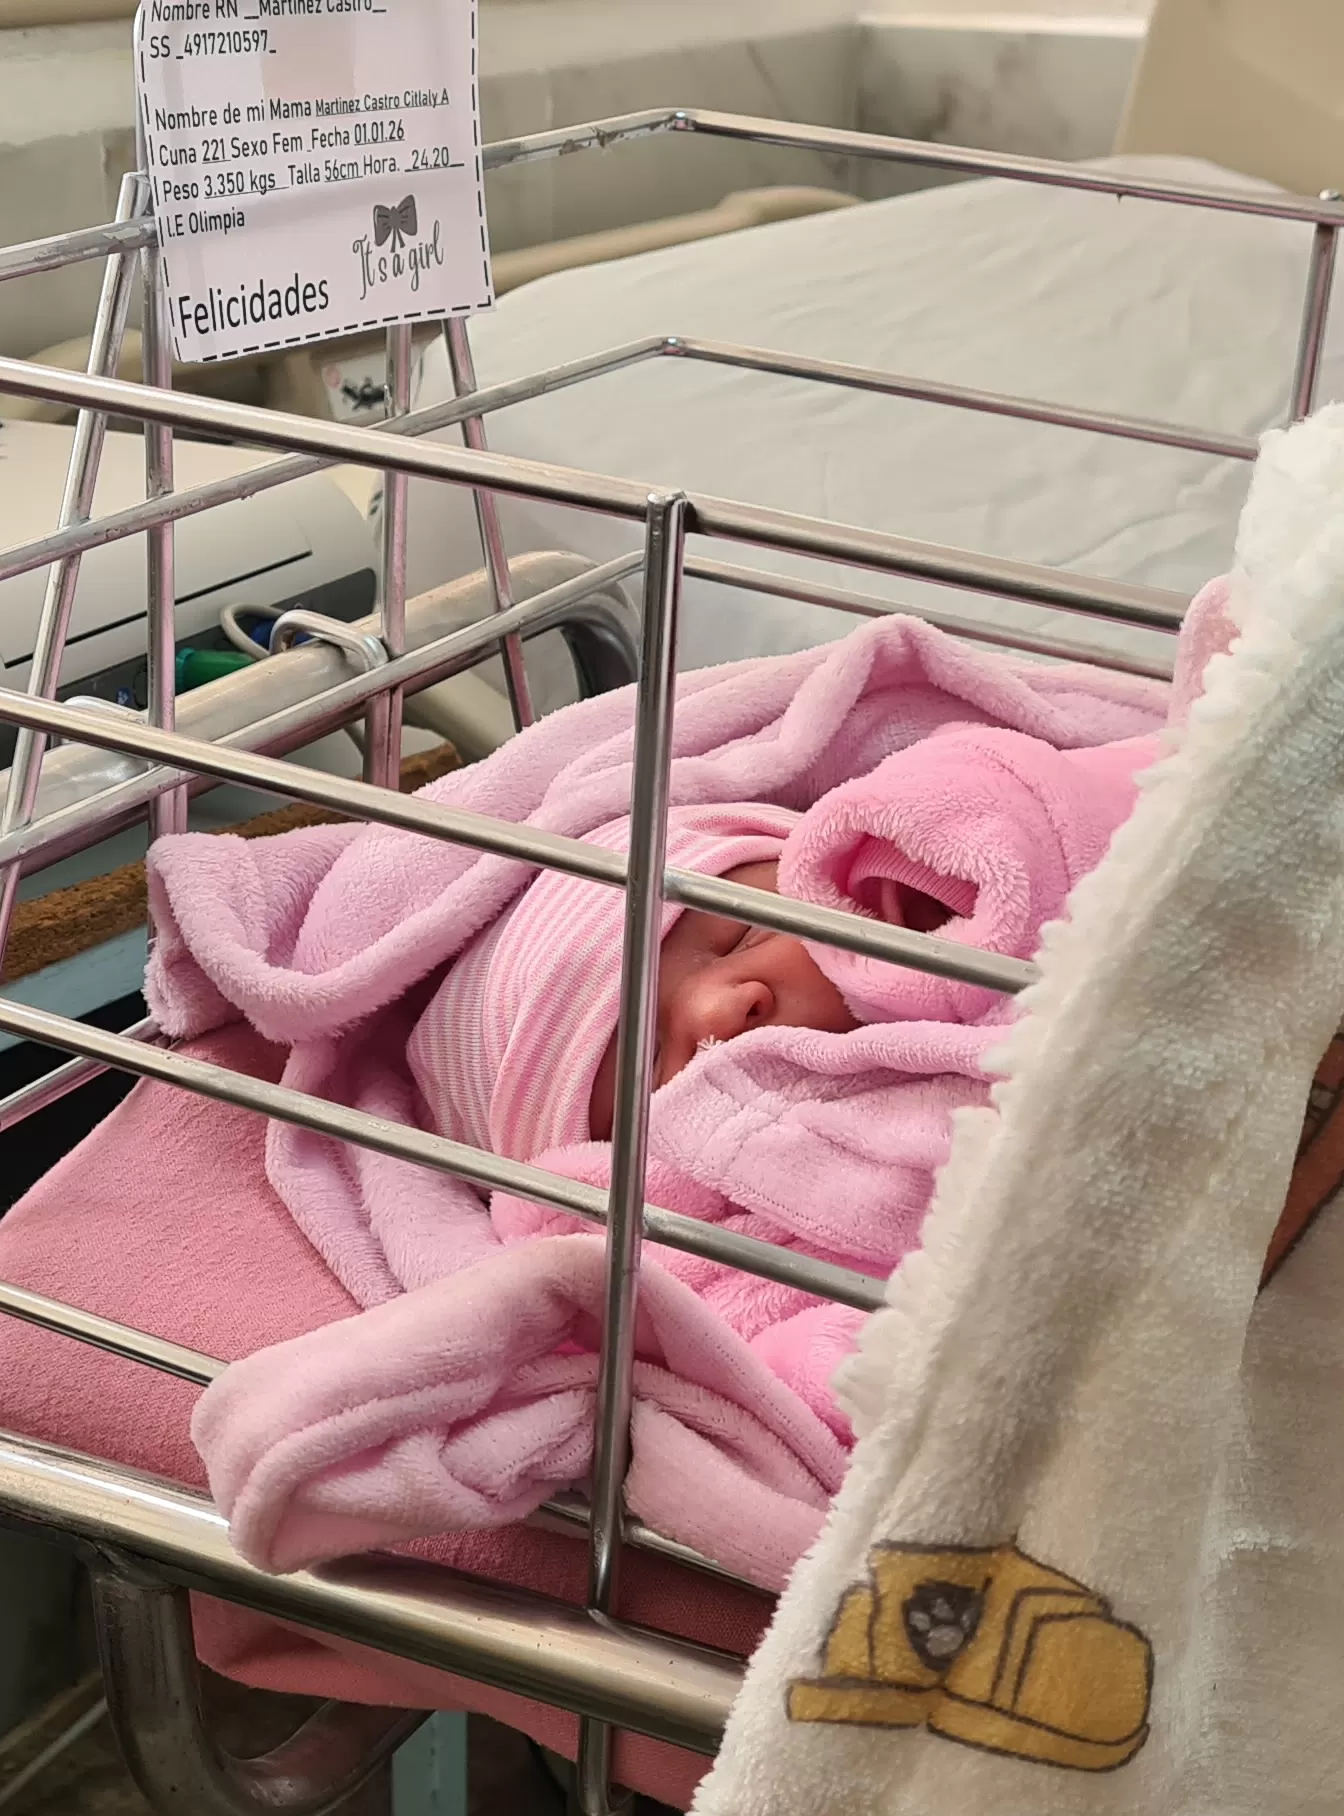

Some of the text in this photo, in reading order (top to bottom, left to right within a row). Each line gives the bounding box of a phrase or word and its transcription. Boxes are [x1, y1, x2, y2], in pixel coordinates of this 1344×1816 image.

[151, 0, 210, 22] Nombre
[216, 0, 238, 18] RN
[149, 35, 170, 58] SS
[155, 88, 449, 131] Nombre de mi Mama Martinez Castro Citlaly A
[159, 144, 196, 167] Cuna
[202, 138, 227, 164] 221
[231, 135, 267, 159] Sexo
[273, 132, 303, 154] Fem
[354, 118, 404, 145] 01.01.26
[163, 180, 199, 202] Peso
[204, 171, 244, 198] 3.350
[288, 163, 320, 186] Talla
[324, 159, 359, 182] 56cm
[363, 154, 400, 176] Hora.
[189, 206, 245, 236] Olimpia
[393, 253, 404, 278] a
[409, 219, 444, 292] girl
[178, 272, 329, 338] Felicidades
